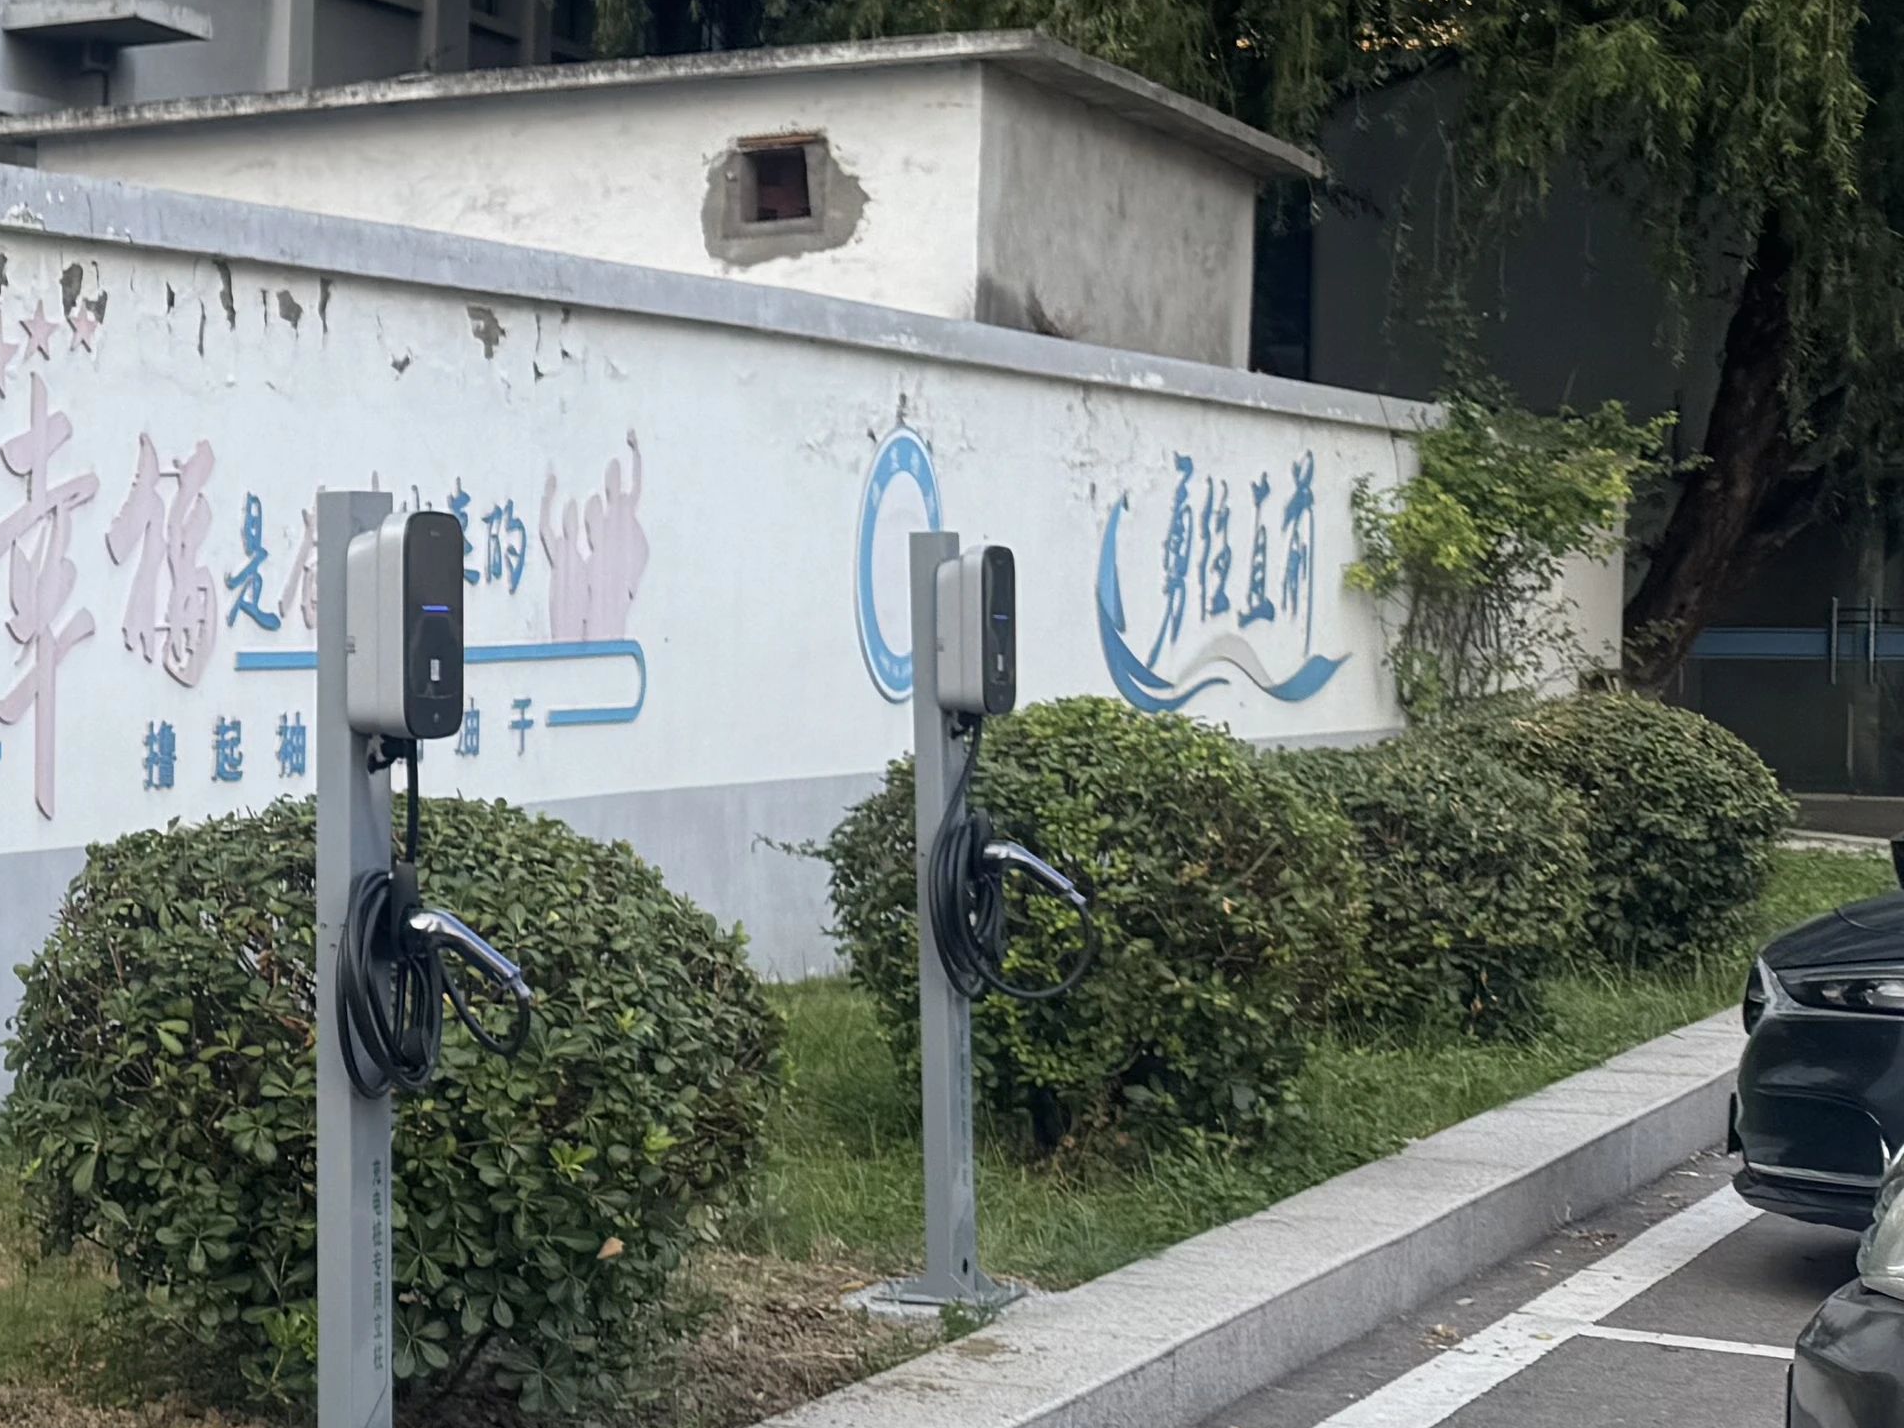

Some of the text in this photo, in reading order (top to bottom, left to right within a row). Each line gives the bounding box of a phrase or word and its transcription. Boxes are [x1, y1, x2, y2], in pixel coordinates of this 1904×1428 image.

[1146, 449, 1314, 670] 勇往直前
[143, 697, 534, 790] 撸起袖油干
